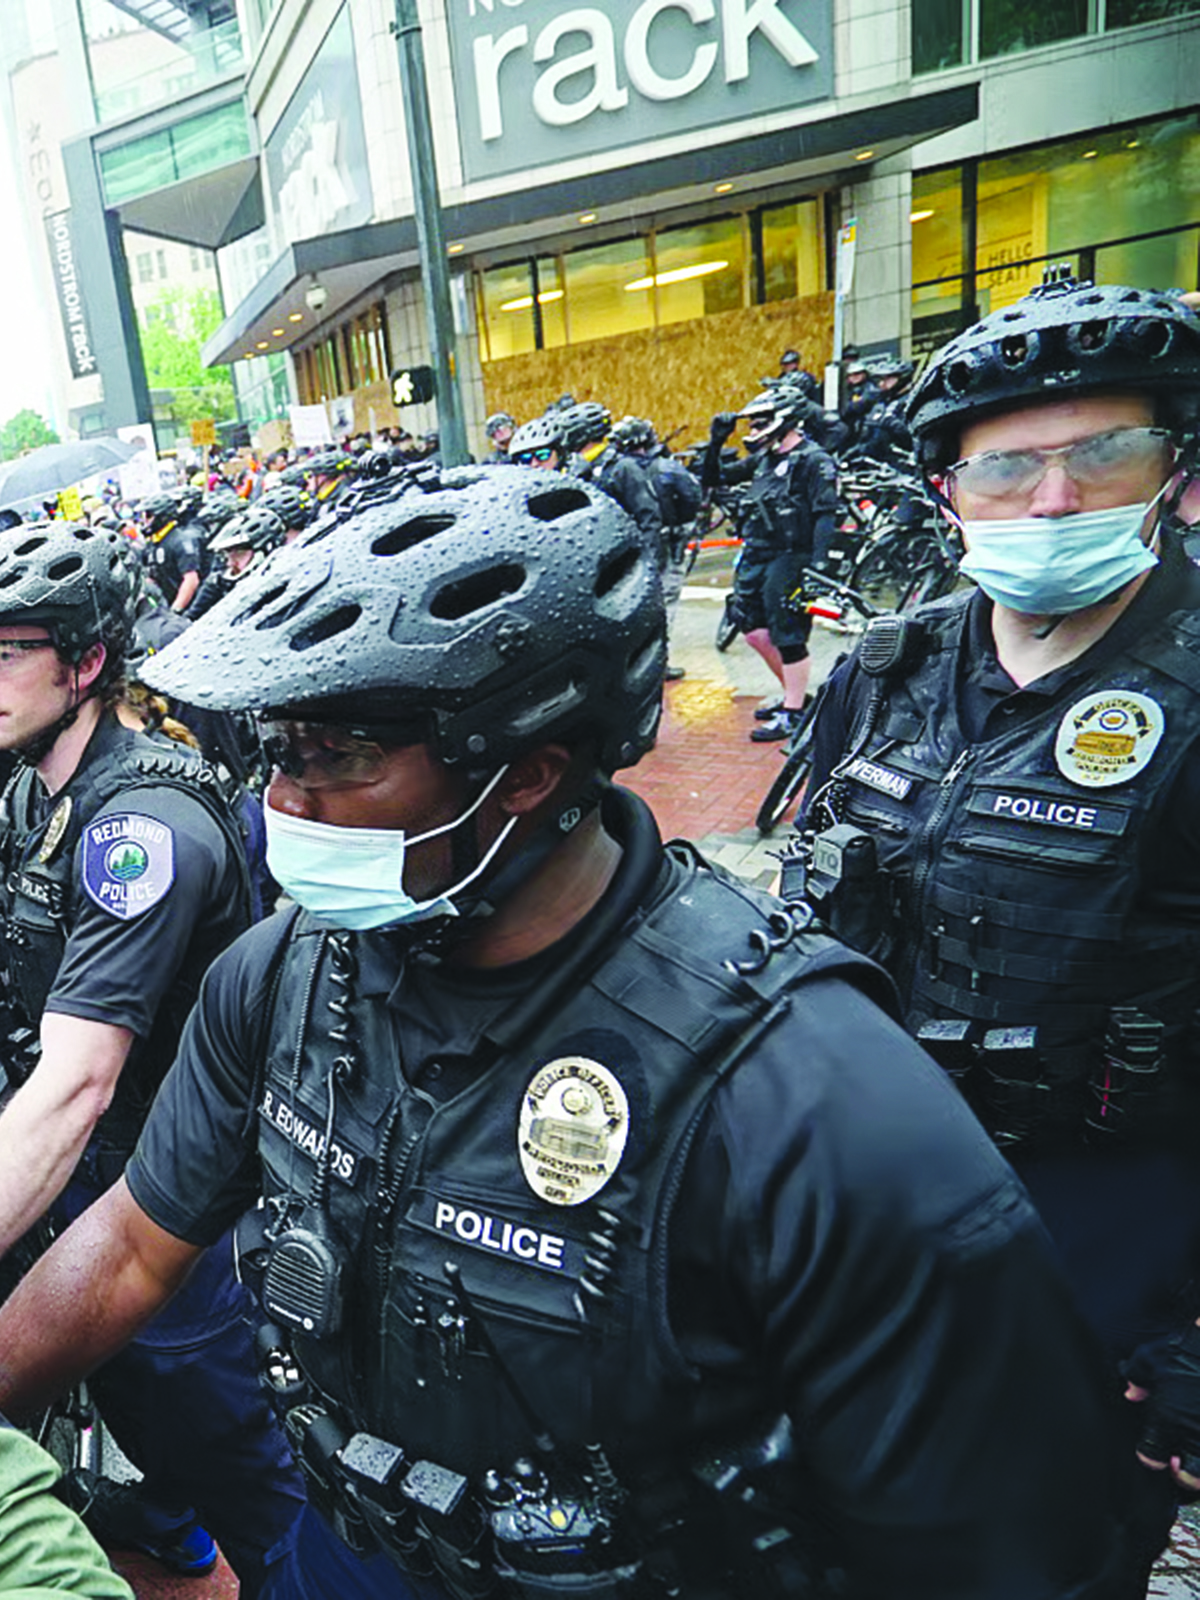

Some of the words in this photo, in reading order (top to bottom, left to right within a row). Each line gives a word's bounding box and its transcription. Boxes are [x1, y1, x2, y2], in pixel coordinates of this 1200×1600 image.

[473, 0, 820, 142] rack
[52, 214, 81, 321] NORDSTROM
[70, 320, 97, 374] rack
[91, 820, 166, 846] REDMOND
[993, 795, 1097, 828] POLICE
[99, 881, 156, 901] POLICE
[435, 1202, 566, 1269] POLICE
